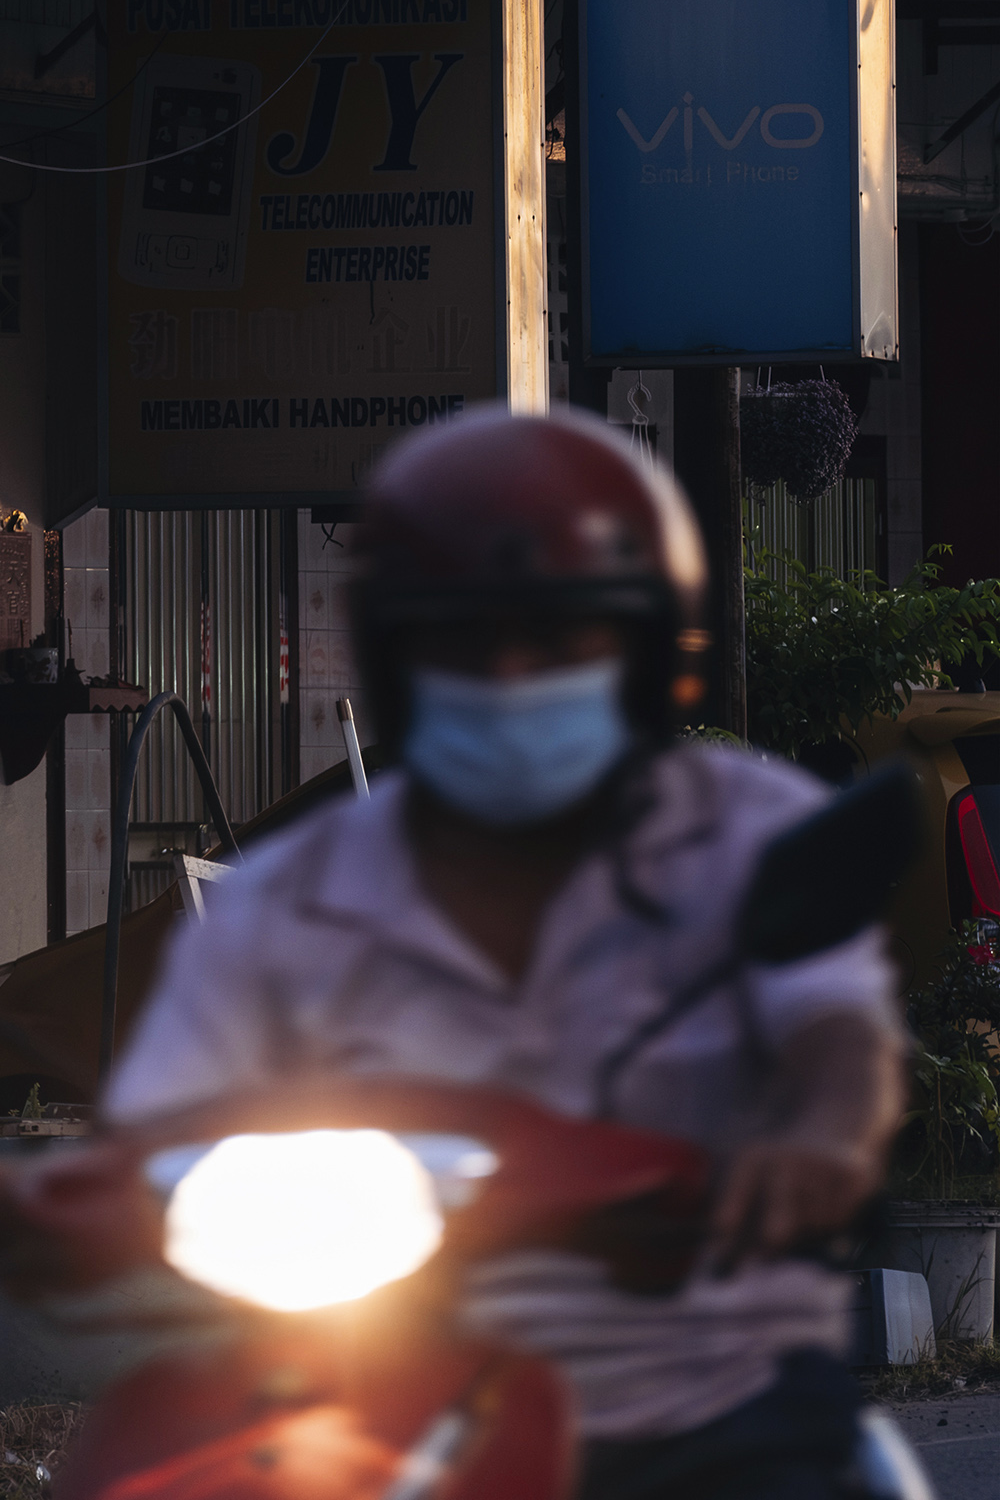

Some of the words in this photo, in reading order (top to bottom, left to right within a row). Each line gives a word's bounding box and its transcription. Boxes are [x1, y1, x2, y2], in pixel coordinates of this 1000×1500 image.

[266, 53, 463, 175] JY
[616, 91, 825, 153] vivo
[726, 160, 799, 185] Phone
[259, 190, 474, 230] TELECOMMUNICATION
[304, 245, 431, 284] ENTERPRISE
[140, 398, 280, 431] MEMBAIKI
[288, 394, 465, 429] HANDPHONE
